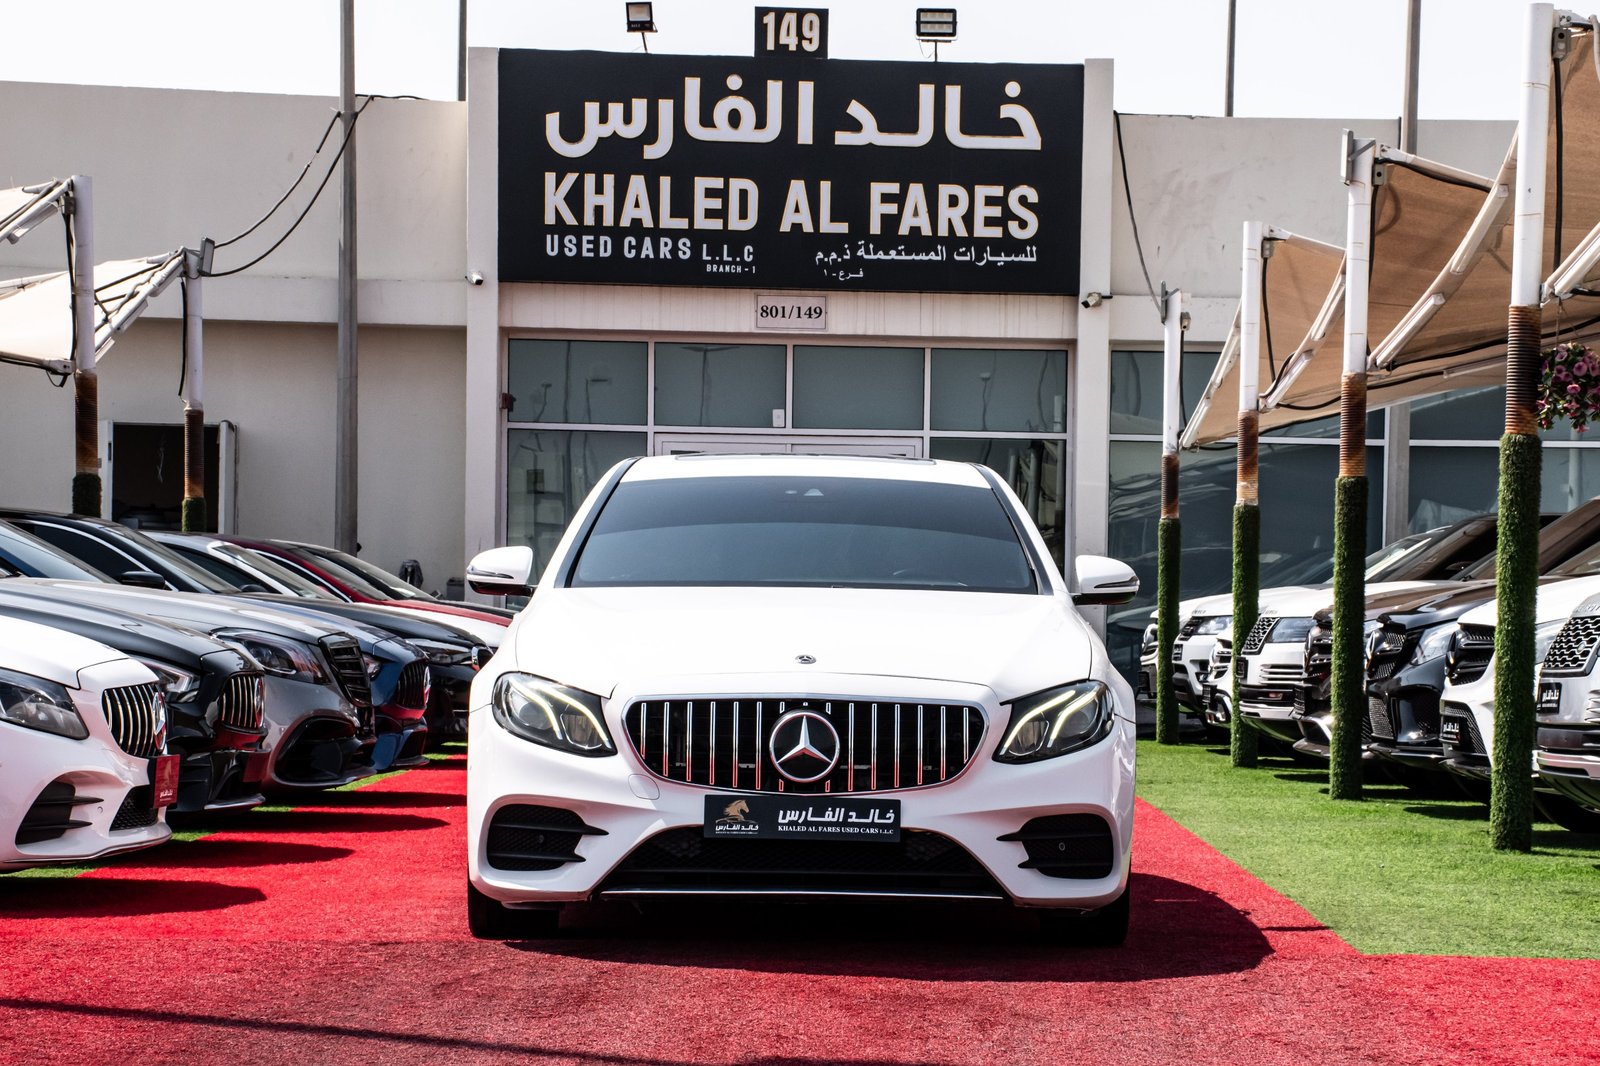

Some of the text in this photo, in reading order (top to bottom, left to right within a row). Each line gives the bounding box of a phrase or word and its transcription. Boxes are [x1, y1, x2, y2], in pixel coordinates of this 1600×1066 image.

[762, 11, 821, 52] 149
[545, 74, 1042, 160] خالد الفارس
[544, 172, 1040, 240] KHALED AL FARES
[546, 234, 754, 262] USED CARS L.L.C
[856, 239, 946, 262] المستعملة
[953, 245, 1037, 267] للسيارات
[706, 264, 742, 274] BRANCH
[752, 266, 756, 274] 1
[838, 268, 864, 281] فرع
[760, 304, 823, 320] 801/149
[777, 806, 895, 824] خالد الفارس
